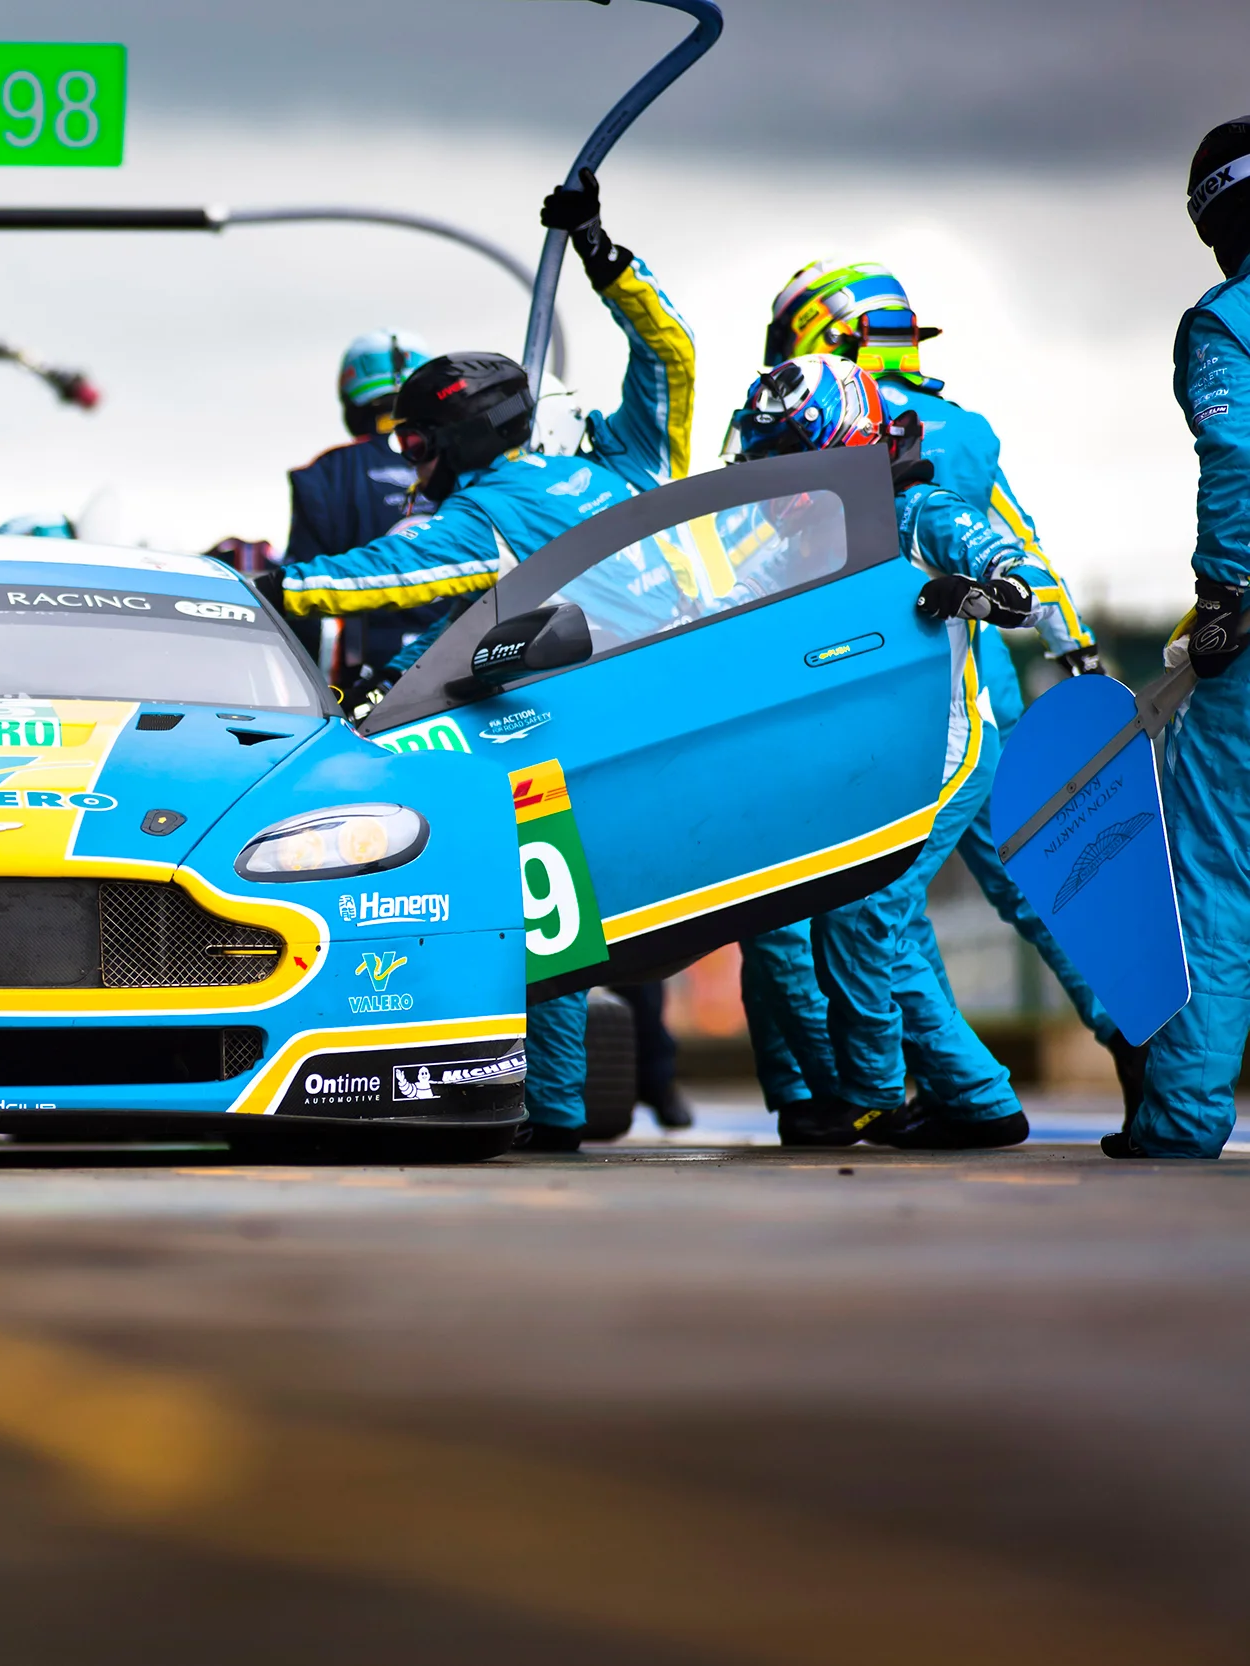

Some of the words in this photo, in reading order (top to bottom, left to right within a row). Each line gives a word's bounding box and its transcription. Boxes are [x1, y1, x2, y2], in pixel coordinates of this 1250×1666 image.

[2, 70, 99, 148] 98
[1191, 165, 1235, 214] uvex
[7, 592, 151, 610] RACING
[490, 641, 526, 660] fmr
[503, 709, 536, 724] ACTION
[503, 721, 524, 732] ROAD
[524, 712, 551, 727] SAFETY
[360, 892, 449, 922] Hanergy
[348, 993, 414, 1013] VALERO
[304, 1072, 381, 1095] Ontime
[304, 1094, 381, 1105] AUTOMOTIVE
